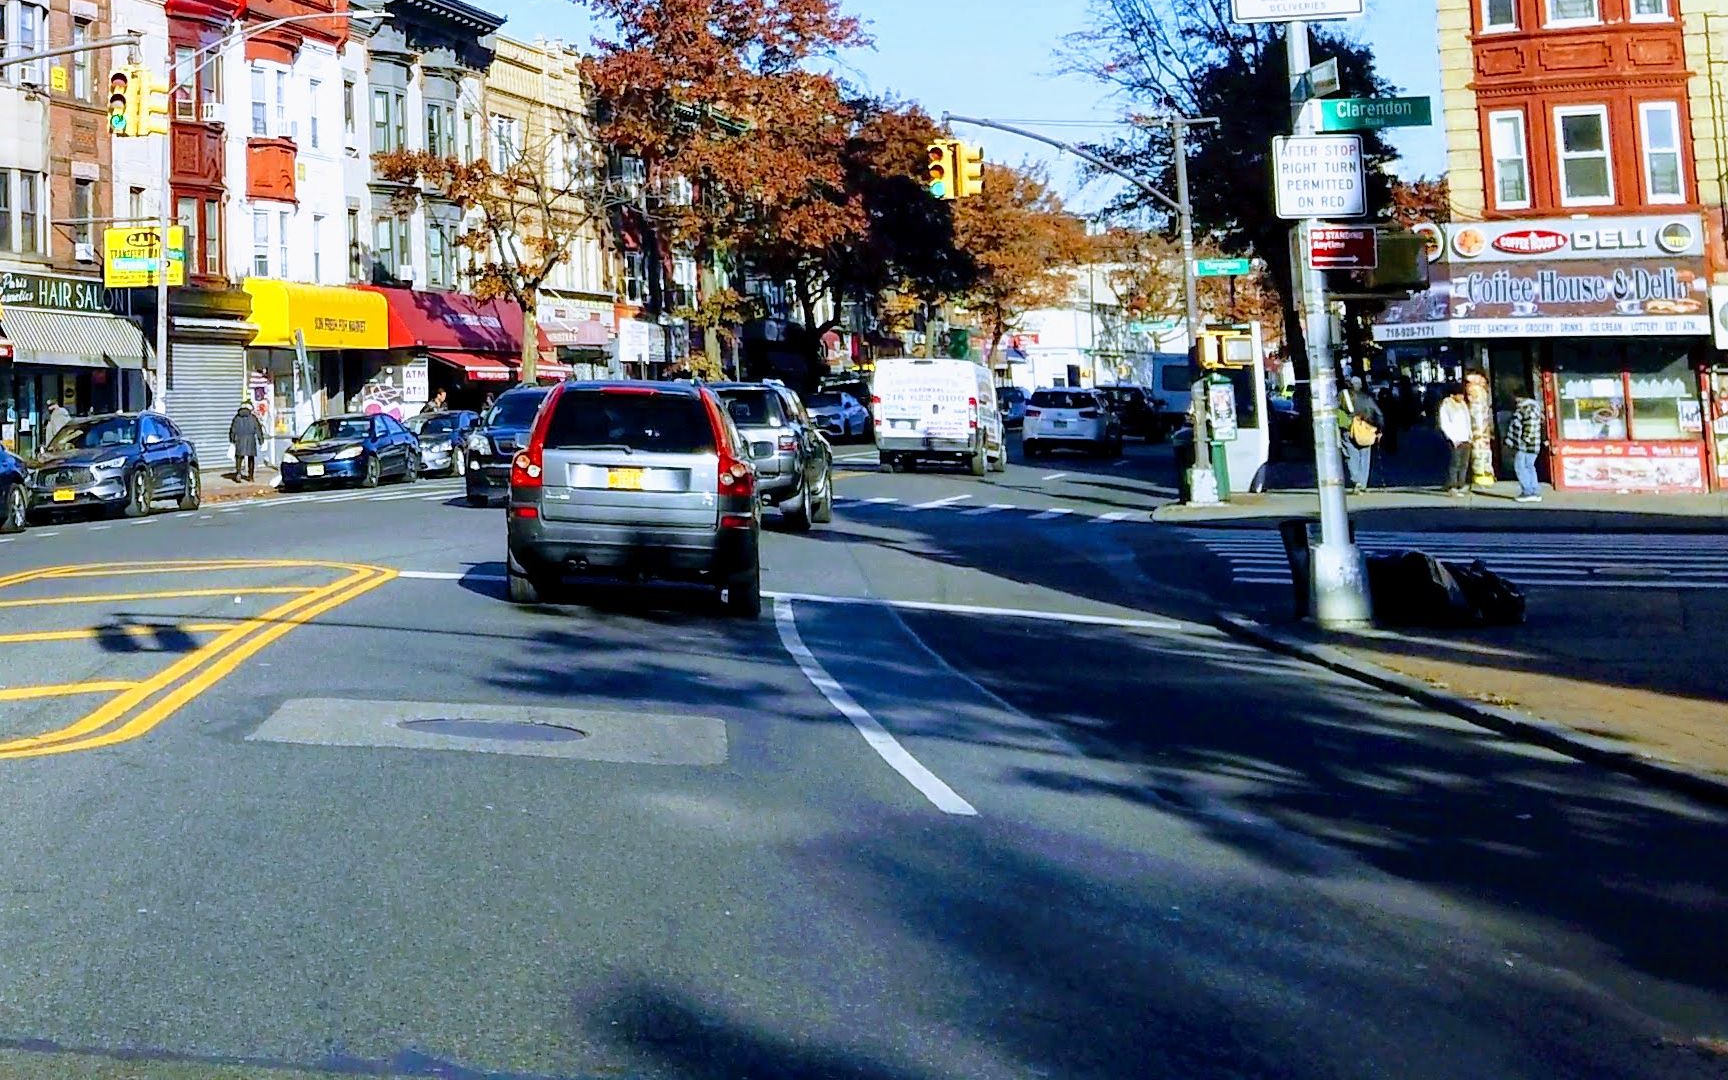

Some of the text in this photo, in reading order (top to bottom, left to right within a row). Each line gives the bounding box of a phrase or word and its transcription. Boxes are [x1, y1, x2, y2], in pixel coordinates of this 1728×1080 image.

[1270, 1, 1326, 13] DELIVERIES
[1336, 101, 1412, 118] Clarendon
[1281, 144, 1357, 156] AFTER STOP
[1282, 162, 1356, 174] RIGHT TURN
[1287, 179, 1354, 190] PERMITTED
[1298, 196, 1345, 207] ON RED
[1312, 231, 1364, 240] NO STANDING
[1573, 227, 1648, 250] DELI
[1313, 241, 1345, 250] Anytime
[2, 272, 28, 289] Paris
[1467, 267, 1676, 304] Coffee House & Deli
[38, 280, 124, 311] HAIR SALON
[1459, 324, 1481, 334] COFFEE
[1488, 323, 1518, 333] SANDWICH
[1526, 324, 1553, 333] GROCERY
[1560, 323, 1583, 332] DRINKS
[1601, 322, 1622, 332] CREAM
[1631, 322, 1658, 331] LOTTERY
[406, 370, 425, 379] ATM
